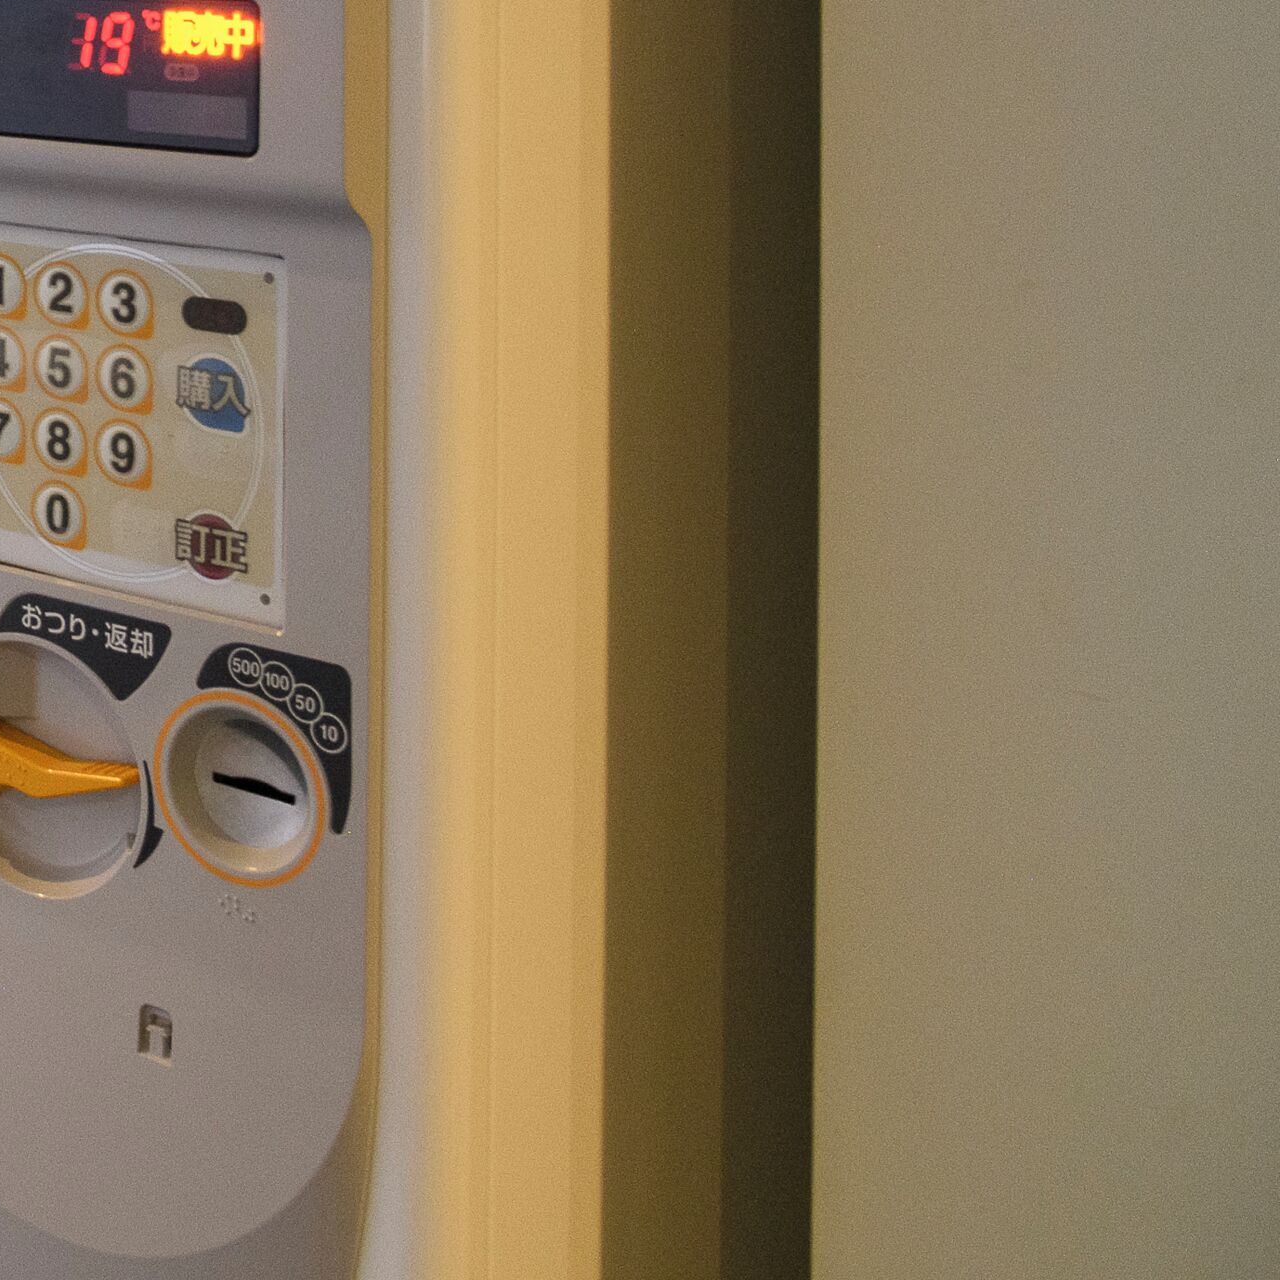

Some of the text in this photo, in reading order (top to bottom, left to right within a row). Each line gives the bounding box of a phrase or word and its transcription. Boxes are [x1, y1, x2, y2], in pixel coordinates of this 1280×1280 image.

[47, 272, 73, 313] 2
[111, 281, 137, 325] 3
[46, 347, 72, 389] 5
[109, 357, 136, 400] 6
[176, 366, 250, 418] 購入
[46, 420, 72, 462] 8
[109, 431, 136, 475] 9
[45, 493, 71, 534] 0
[175, 519, 248, 574] 訂正
[21, 603, 154, 659] おつり・返却
[232, 656, 260, 678] 500
[263, 670, 290, 692] 100
[294, 694, 316, 712] 50
[320, 724, 338, 742] 10
